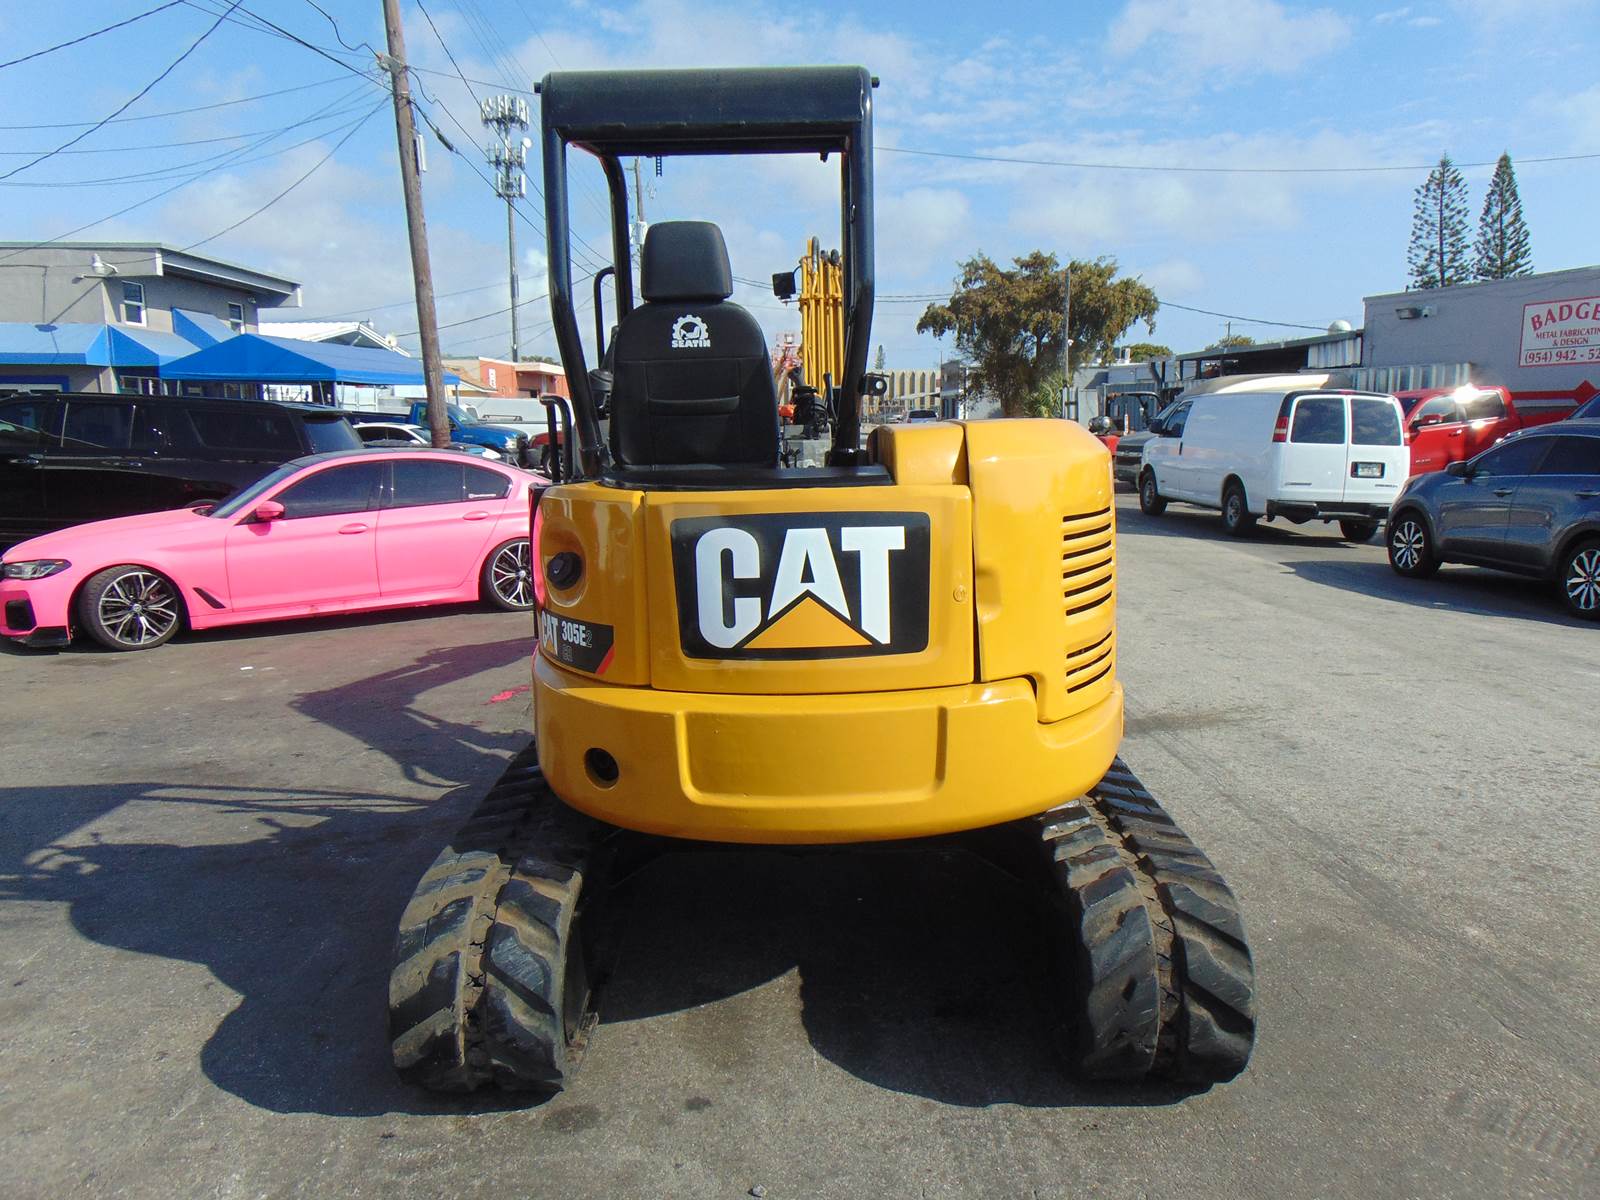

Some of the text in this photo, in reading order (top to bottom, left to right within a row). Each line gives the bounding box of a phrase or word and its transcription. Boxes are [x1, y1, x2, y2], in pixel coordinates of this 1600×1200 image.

[1536, 331, 1557, 339] METAL
[1560, 337, 1589, 346] DESIGN
[1525, 351, 1552, 364] (954)
[1555, 349, 1577, 362] 942
[696, 525, 906, 649] CAT
[541, 610, 559, 657] CAT
